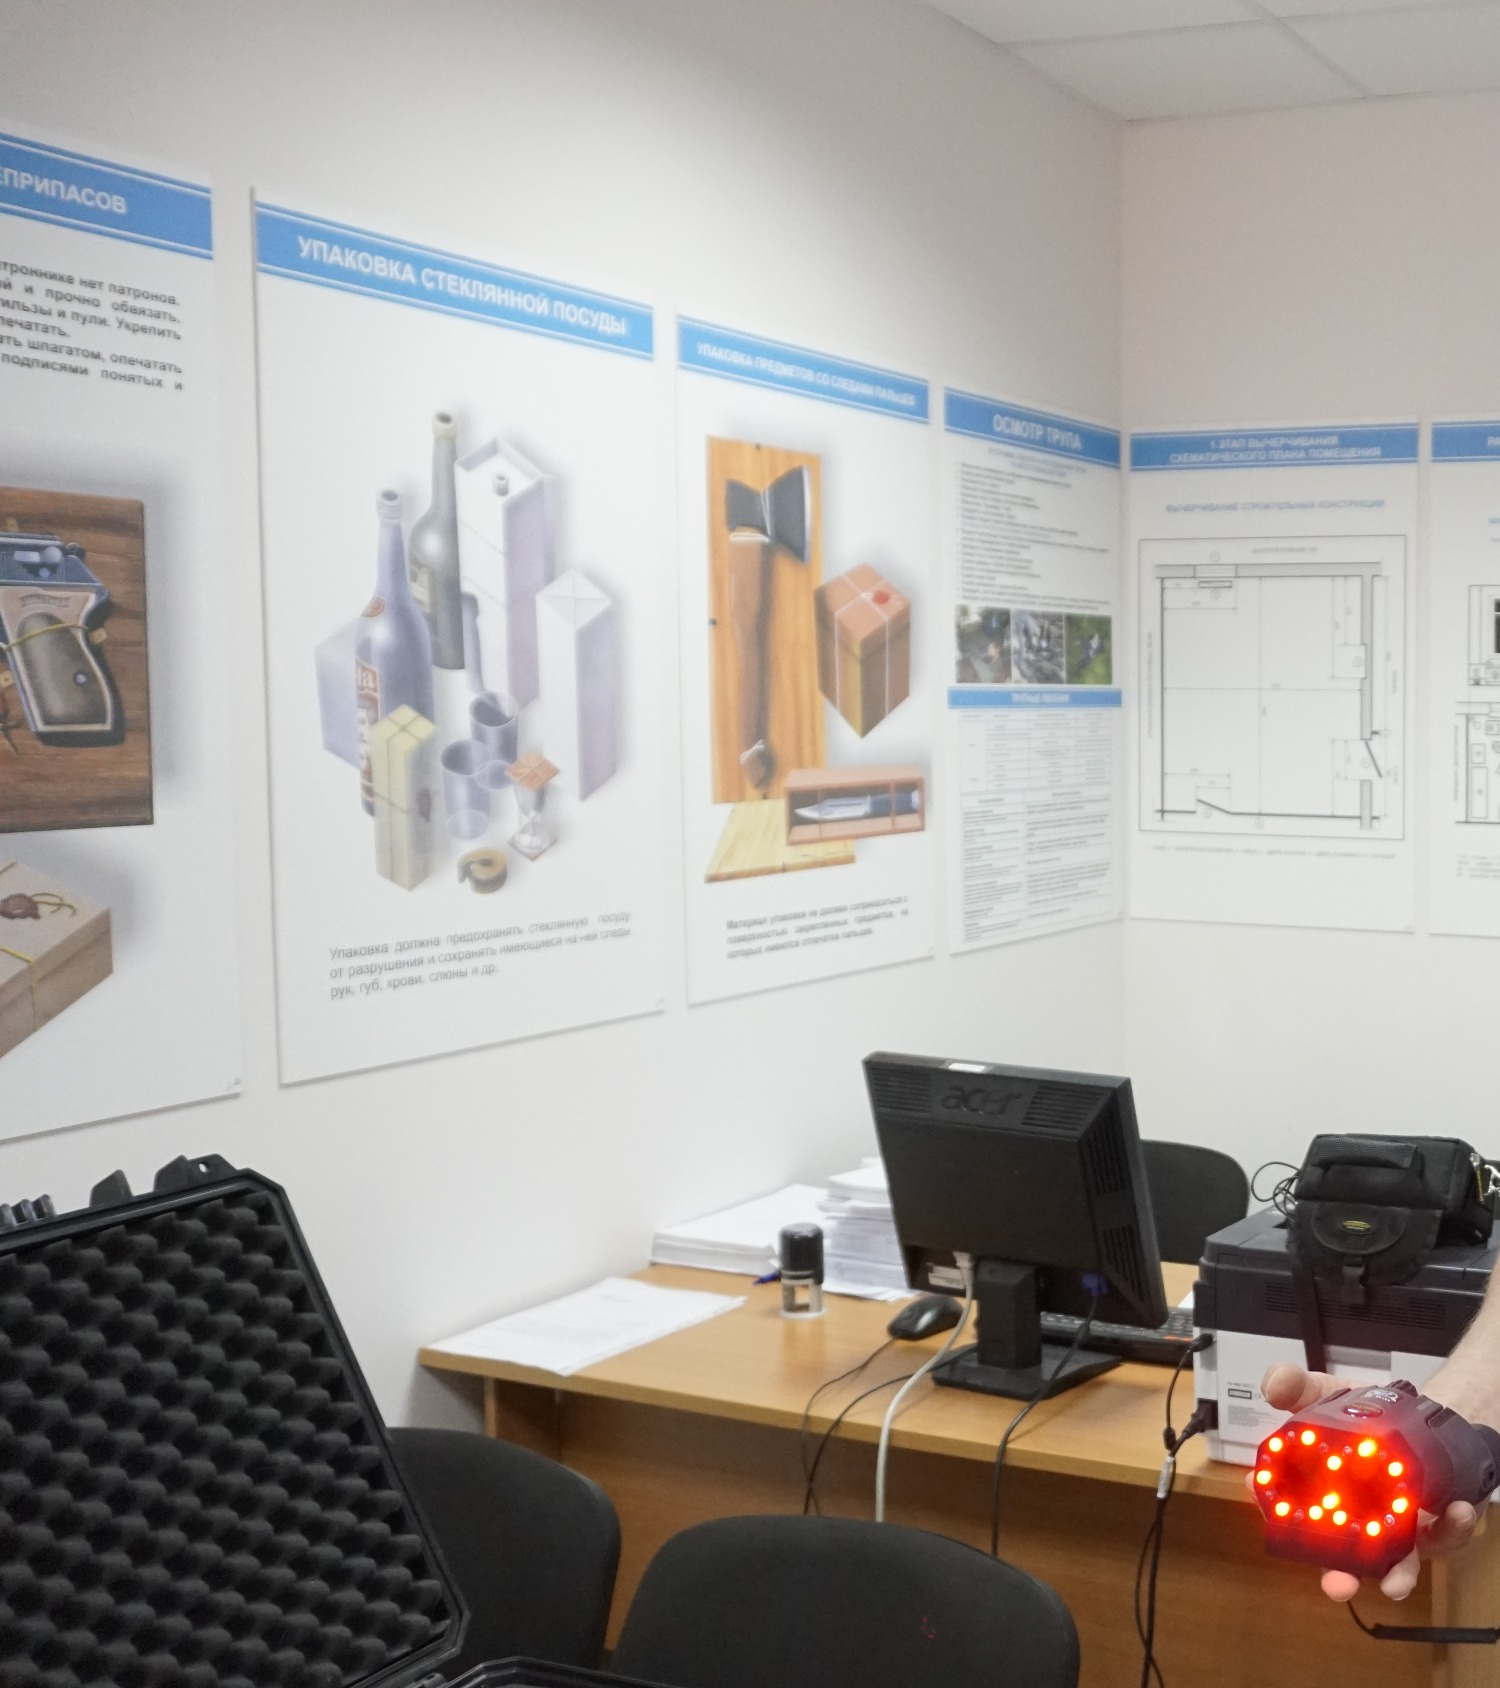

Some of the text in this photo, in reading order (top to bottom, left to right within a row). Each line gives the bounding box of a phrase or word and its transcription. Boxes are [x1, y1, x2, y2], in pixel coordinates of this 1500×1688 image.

[80, 277, 104, 290] нет
[108, 283, 179, 305] патронов.
[297, 235, 627, 336] УПАКОВКА СТЕКЛЯННОЙ ПОСУДЫ
[0, 297, 181, 340] ильзы и пули. Укрепить
[45, 287, 100, 307] прочно
[111, 300, 181, 323] обвязать.
[1, 353, 183, 391] подписями понятых и
[27, 338, 105, 362] шпагатом,
[110, 353, 182, 374] опечатать
[697, 341, 752, 368] УПАКОВКА
[754, 355, 815, 382] ПРЕДМЕТОВ
[816, 370, 829, 385] СО
[831, 375, 874, 396] СЛЕДАМИ
[992, 414, 1082, 450] ОСМОТР ТРУПА
[1219, 437, 1246, 449] ЭТАП
[1248, 435, 1339, 448] ВЫЧЕРЧИВАНИЯ
[1169, 446, 1382, 464] СХЕМАТИЧЕСКОГО ПЛАНА ПОМЕЩЕНИЯ
[330, 910, 630, 960] Упаковка должна предохранять стеклянную посуду
[726, 916, 767, 930] Материал
[329, 967, 344, 979] от
[348, 956, 424, 978] разрушения
[438, 946, 496, 964] сохранять
[500, 936, 561, 955] имеющиеся
[565, 934, 577, 945] на
[600, 926, 631, 940] следы
[330, 983, 355, 1000] рук,
[359, 976, 383, 995] губ,
[387, 974, 425, 991] крови,
[429, 966, 468, 984] слюны
[481, 962, 498, 978] др.
[941, 1086, 1022, 1116] acer
